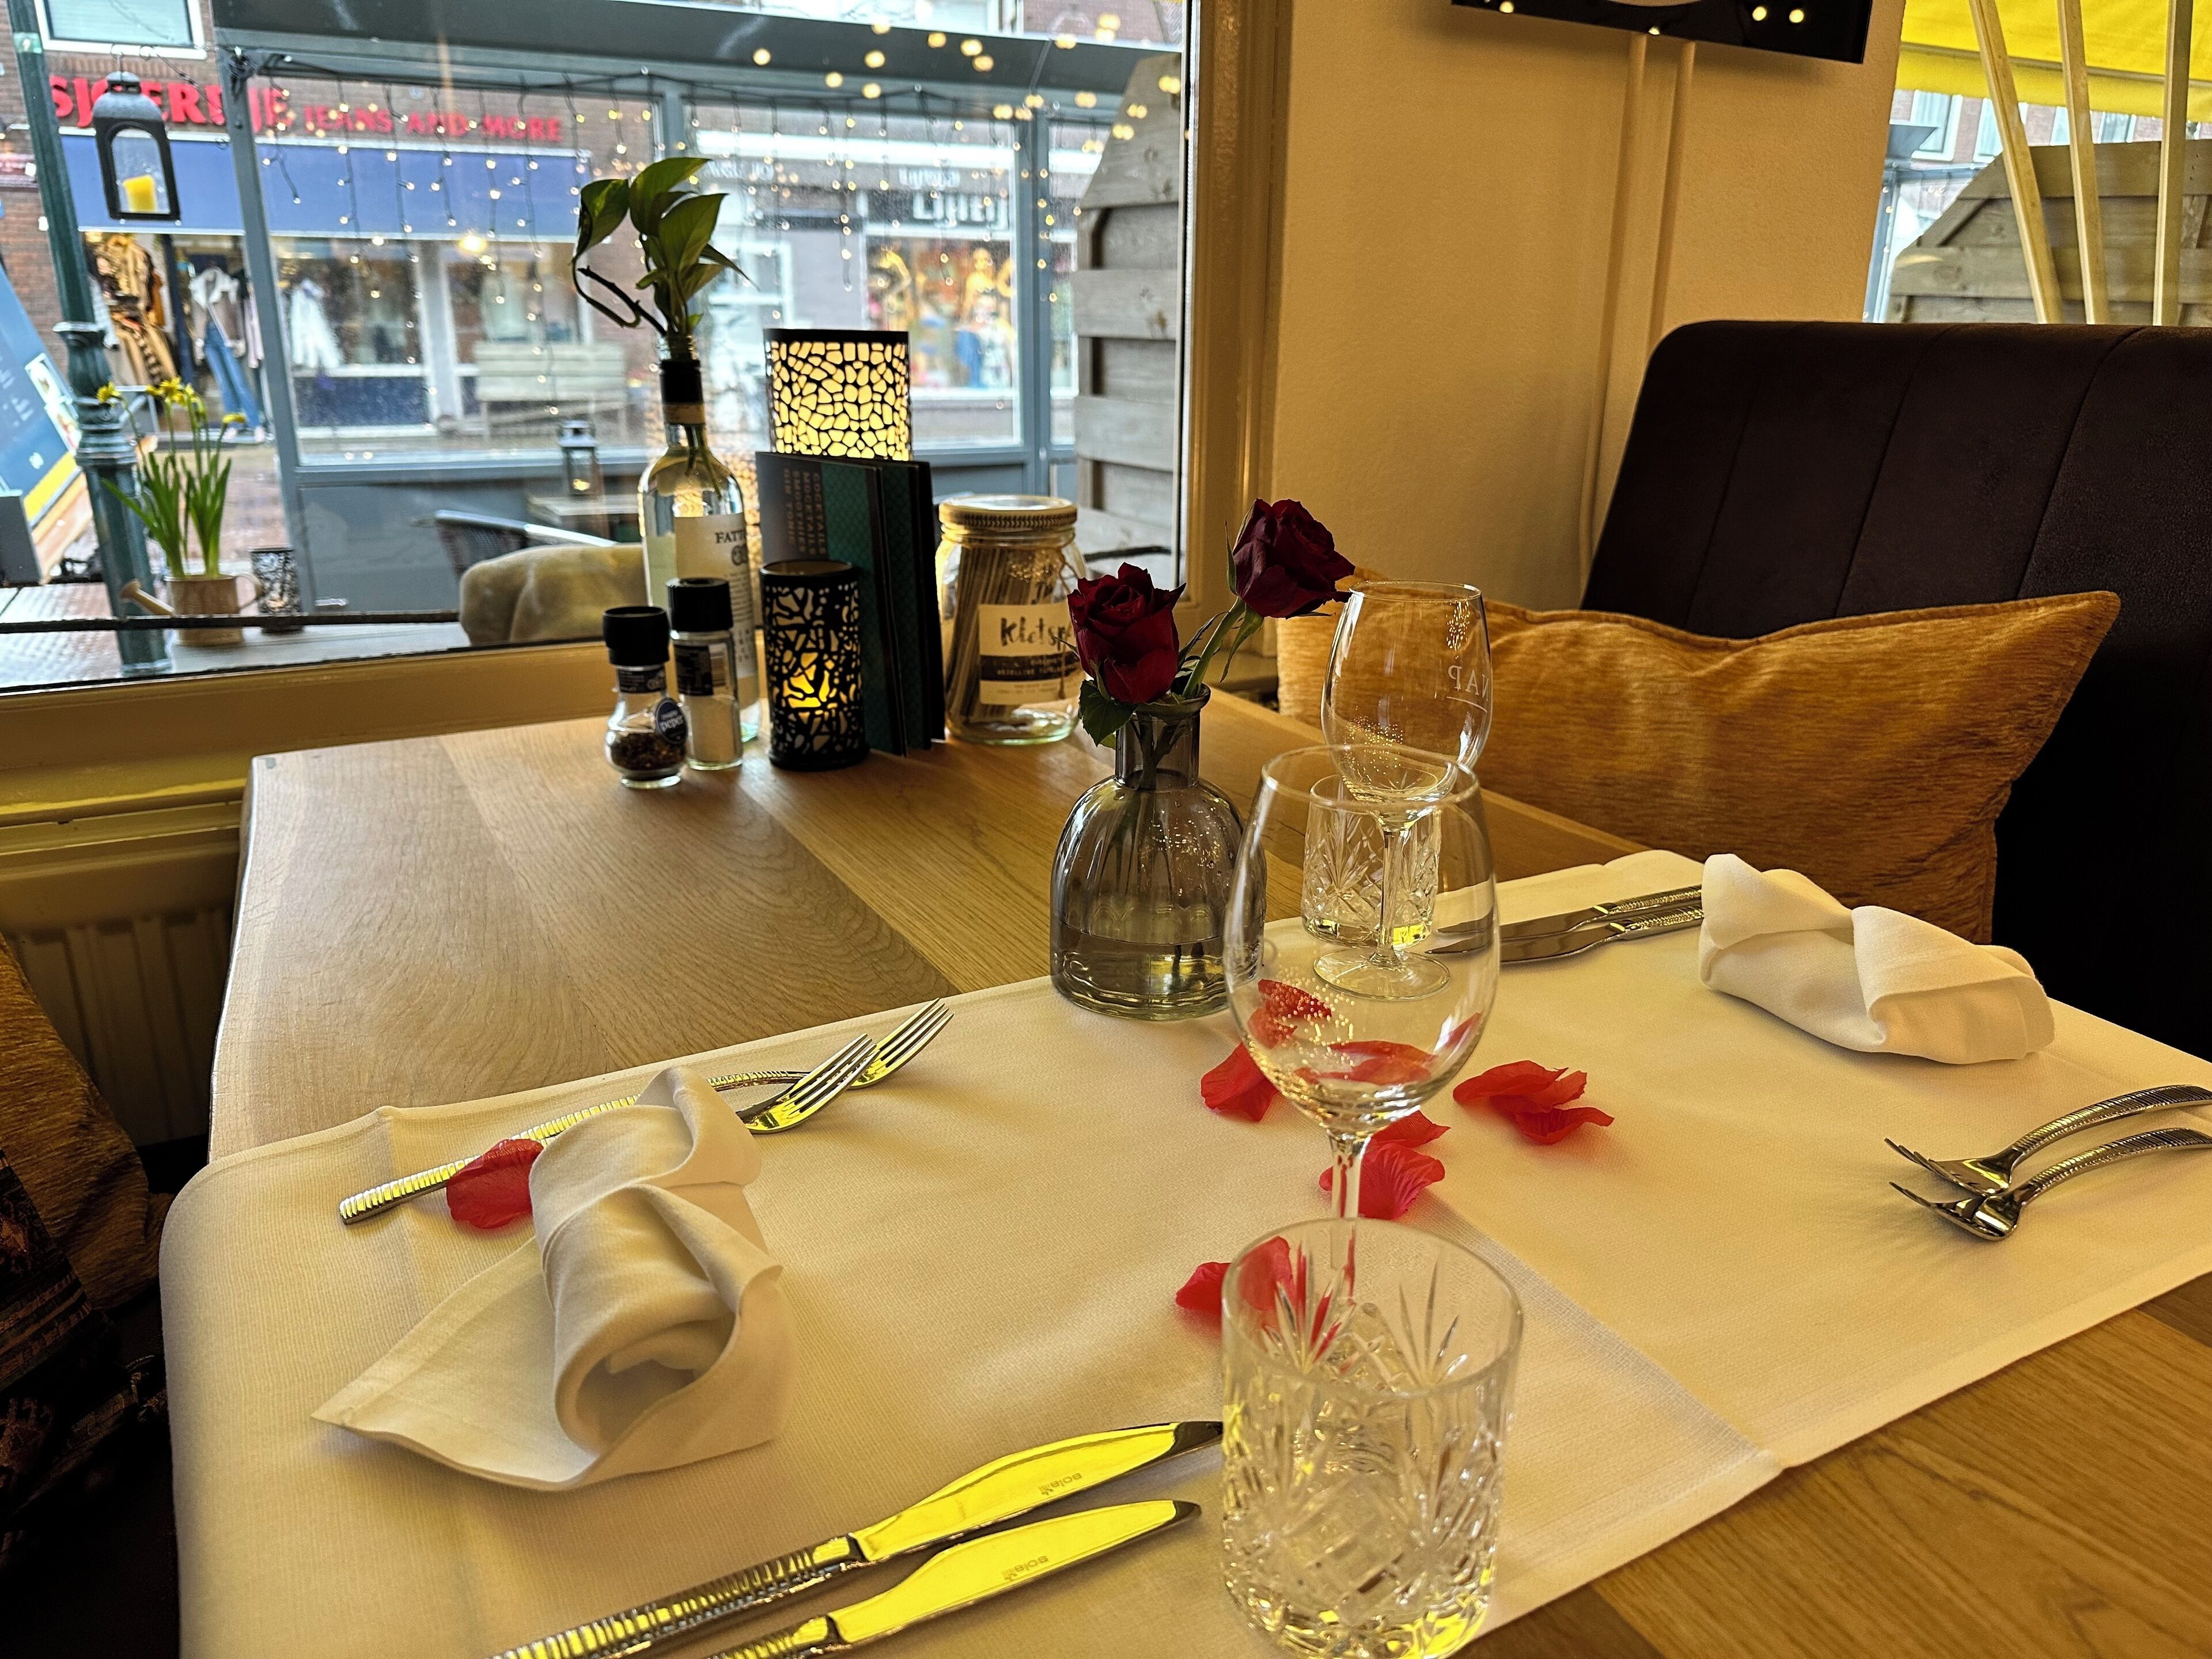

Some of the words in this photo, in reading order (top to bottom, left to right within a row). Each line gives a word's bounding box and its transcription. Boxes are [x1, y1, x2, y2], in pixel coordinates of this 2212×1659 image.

[304, 105, 394, 134] JEANS
[406, 111, 469, 138] AND
[482, 113, 563, 143] MORE
[1052, 1472, 1082, 1488] sola
[1015, 1555, 1048, 1573] sola
